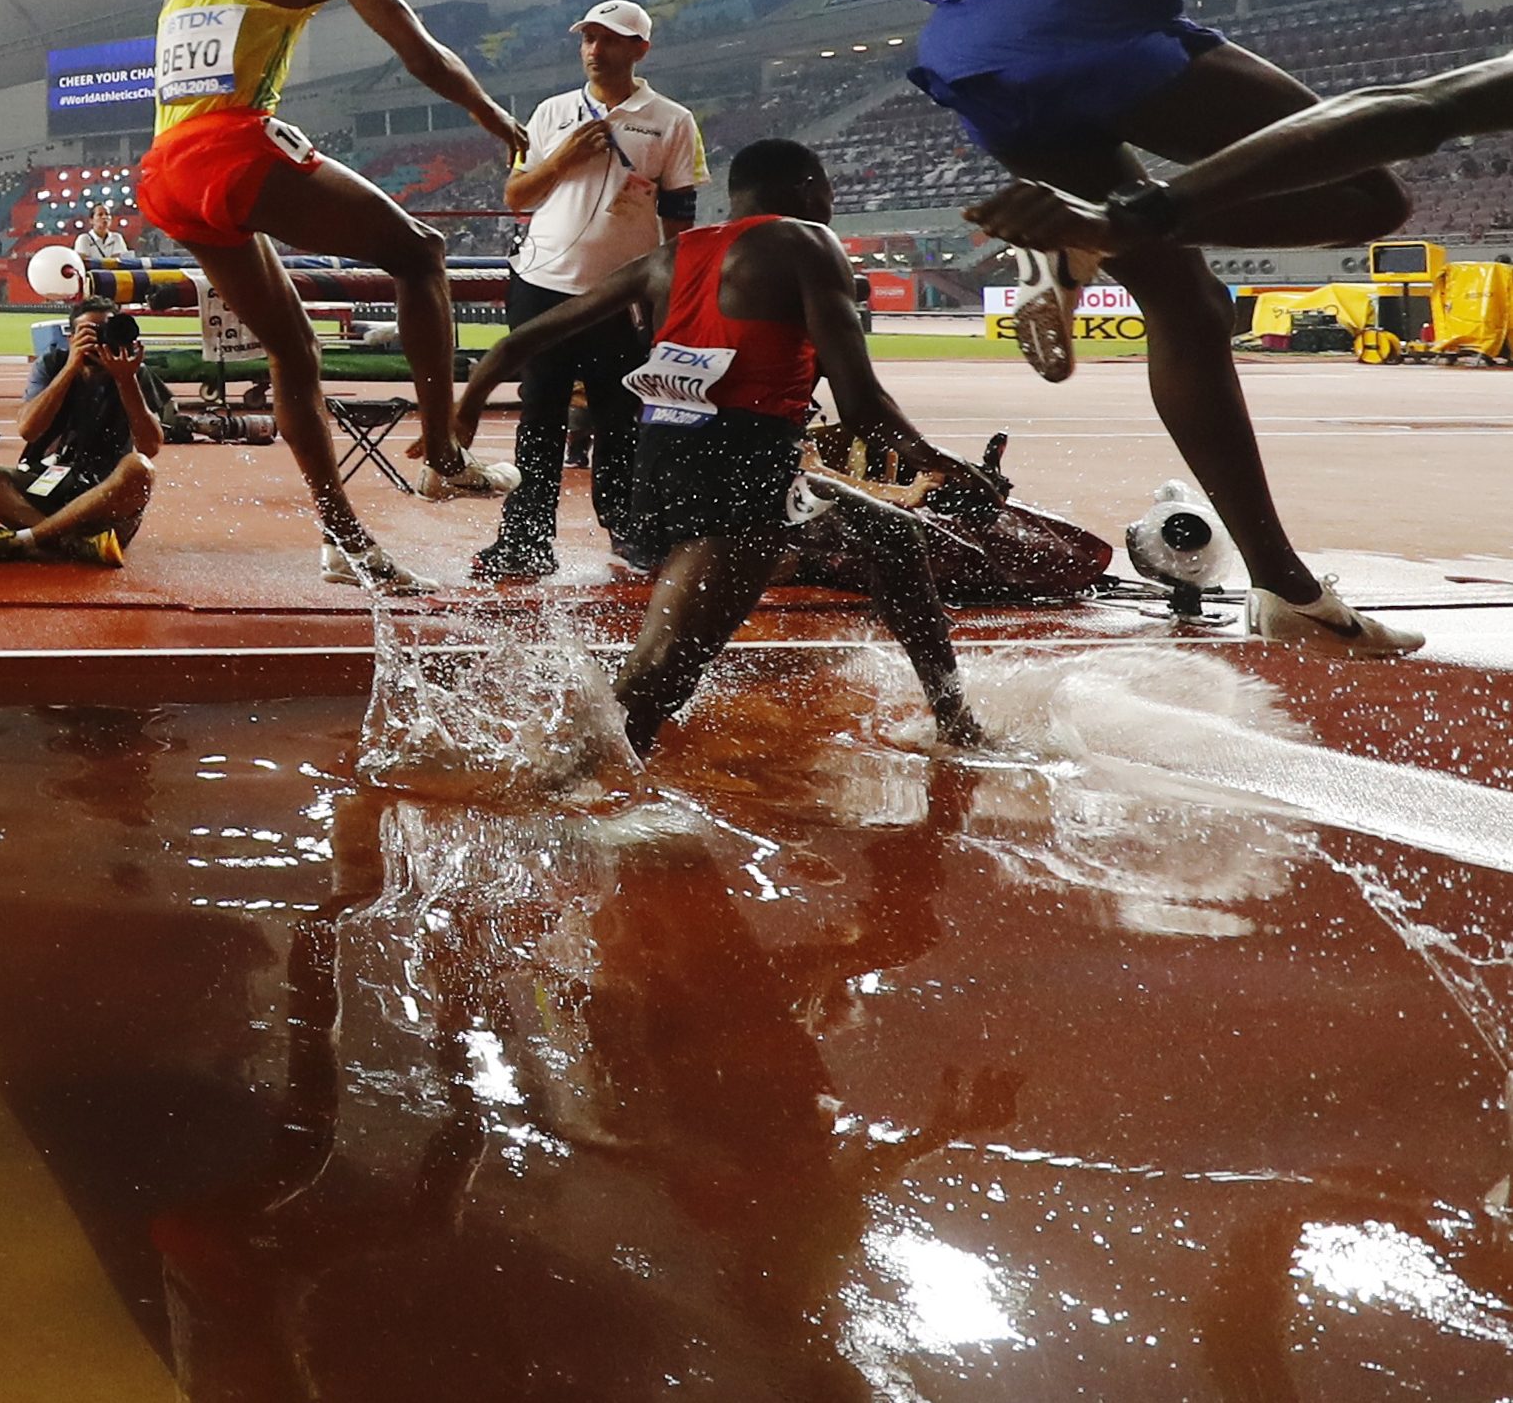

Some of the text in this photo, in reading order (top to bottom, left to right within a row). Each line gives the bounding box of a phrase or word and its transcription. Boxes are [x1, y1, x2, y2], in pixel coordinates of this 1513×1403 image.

[176, 10, 225, 31] TDK
[59, 74, 94, 88] CHEER
[95, 70, 128, 84] YOUR
[59, 88, 157, 106] #WorldAthleticsCha
[660, 347, 716, 369] TDK
